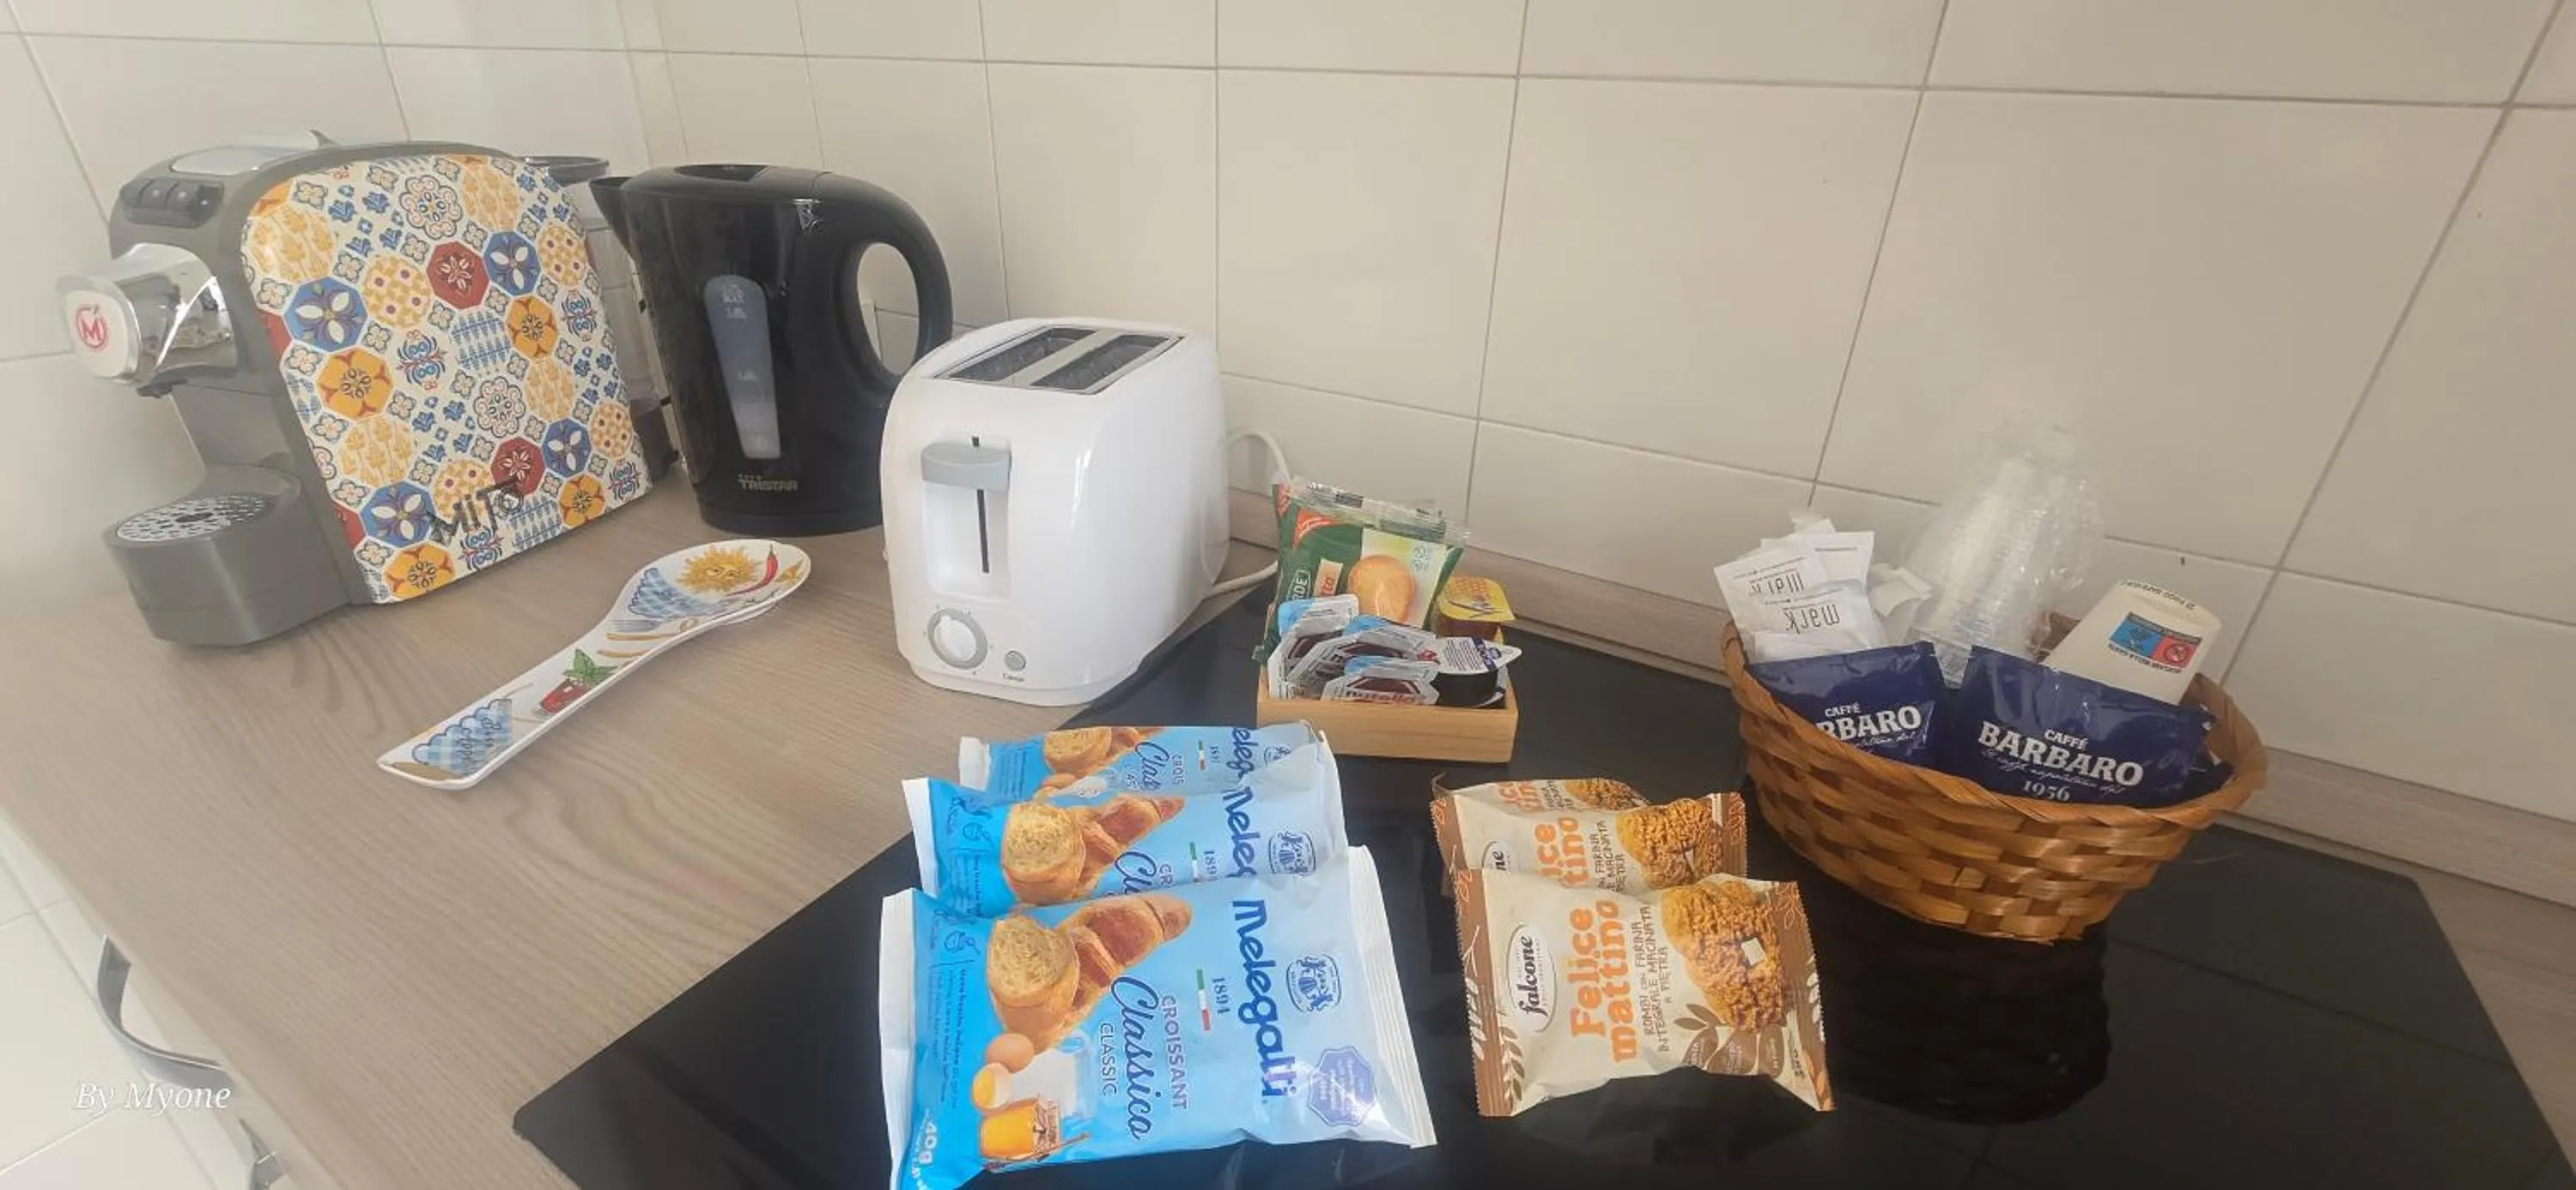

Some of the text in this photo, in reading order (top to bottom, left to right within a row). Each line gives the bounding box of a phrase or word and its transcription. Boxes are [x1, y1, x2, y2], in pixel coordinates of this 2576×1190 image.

[1816, 706, 1922, 741] RBARO
[1978, 720, 2143, 786] BARBARO
[2023, 780, 2070, 801] 1956
[1516, 935, 1548, 1017] falcone
[1567, 907, 1605, 1037] Felice
[1595, 900, 1637, 1063] mattino
[1631, 921, 1646, 968] FARINA
[1640, 906, 1670, 1052] INTEGRALE MACINATA
[1658, 947, 1671, 991] PIETRA
[1212, 977, 1230, 1014] 1894
[1232, 899, 1297, 1097] Melegatti
[1100, 1023, 1116, 1096] CLASSIC
[1111, 976, 1161, 1140] Classico
[1161, 995, 1187, 1109] CROISSANT
